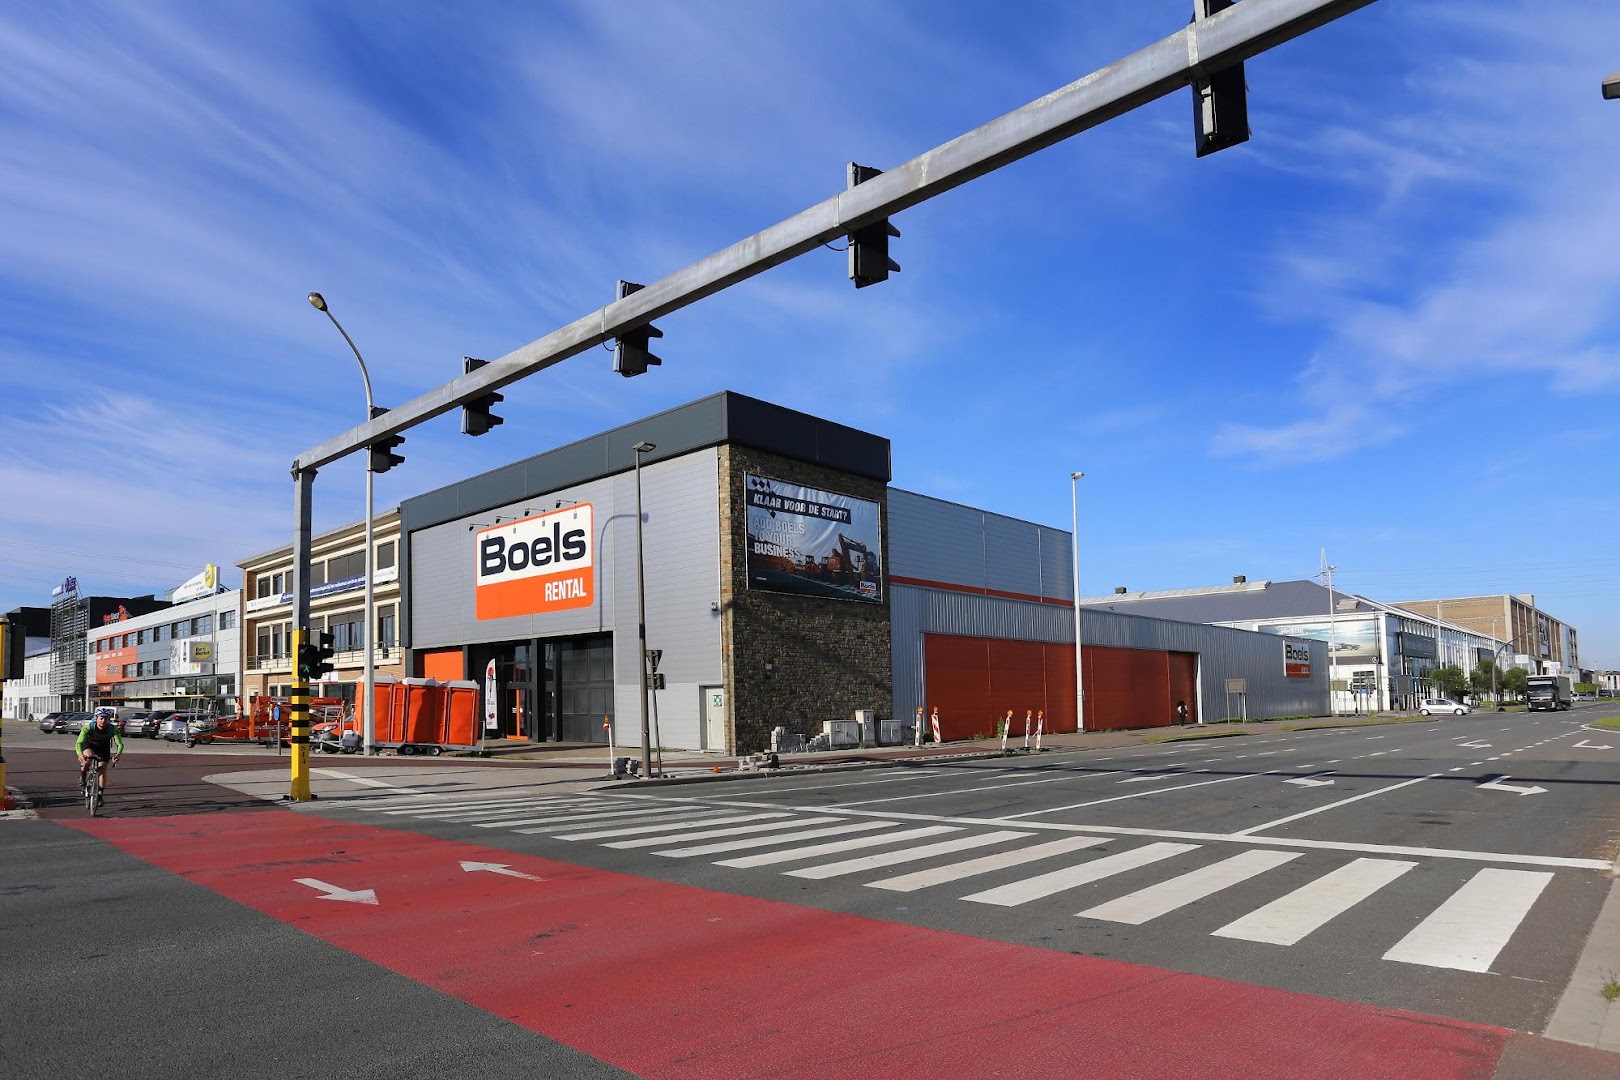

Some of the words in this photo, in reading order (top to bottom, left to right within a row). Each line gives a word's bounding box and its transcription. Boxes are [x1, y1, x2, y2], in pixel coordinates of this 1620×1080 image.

[754, 493, 782, 509] KLAAR
[784, 500, 806, 512] VOOR
[808, 504, 819, 515] DE
[821, 506, 848, 520] START?
[754, 517, 772, 530] ADD
[775, 520, 805, 535] BOELS
[754, 530, 765, 541] TO
[766, 531, 792, 546] YOUR
[481, 522, 586, 577] Boels
[754, 542, 801, 559] BUSINESS
[545, 577, 587, 602] RENTAL
[1286, 644, 1309, 661] Boels
